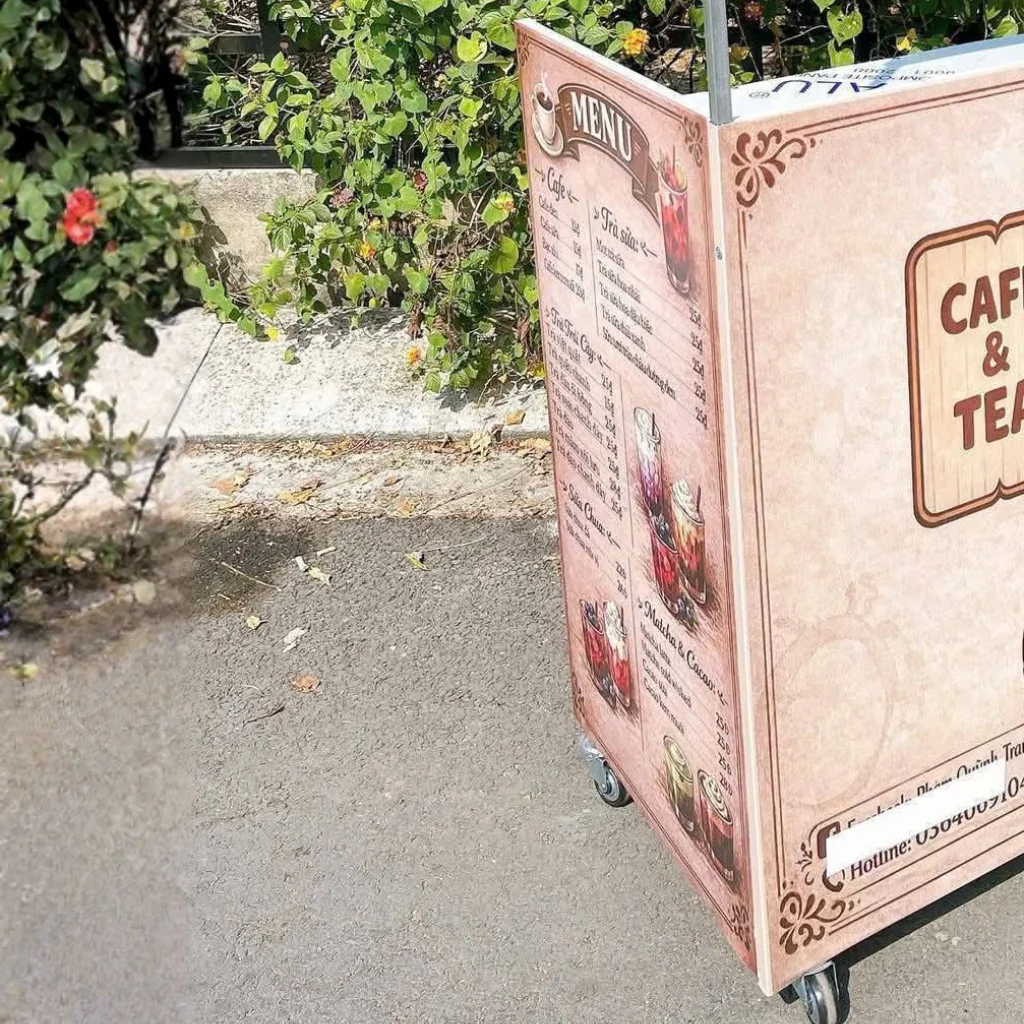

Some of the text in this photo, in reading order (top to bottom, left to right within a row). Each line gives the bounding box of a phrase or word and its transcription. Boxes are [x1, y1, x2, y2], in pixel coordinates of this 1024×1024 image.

[569, 91, 633, 162] MENU
[982, 330, 1010, 377] &
[644, 596, 715, 698] Matcha & Cacao:
